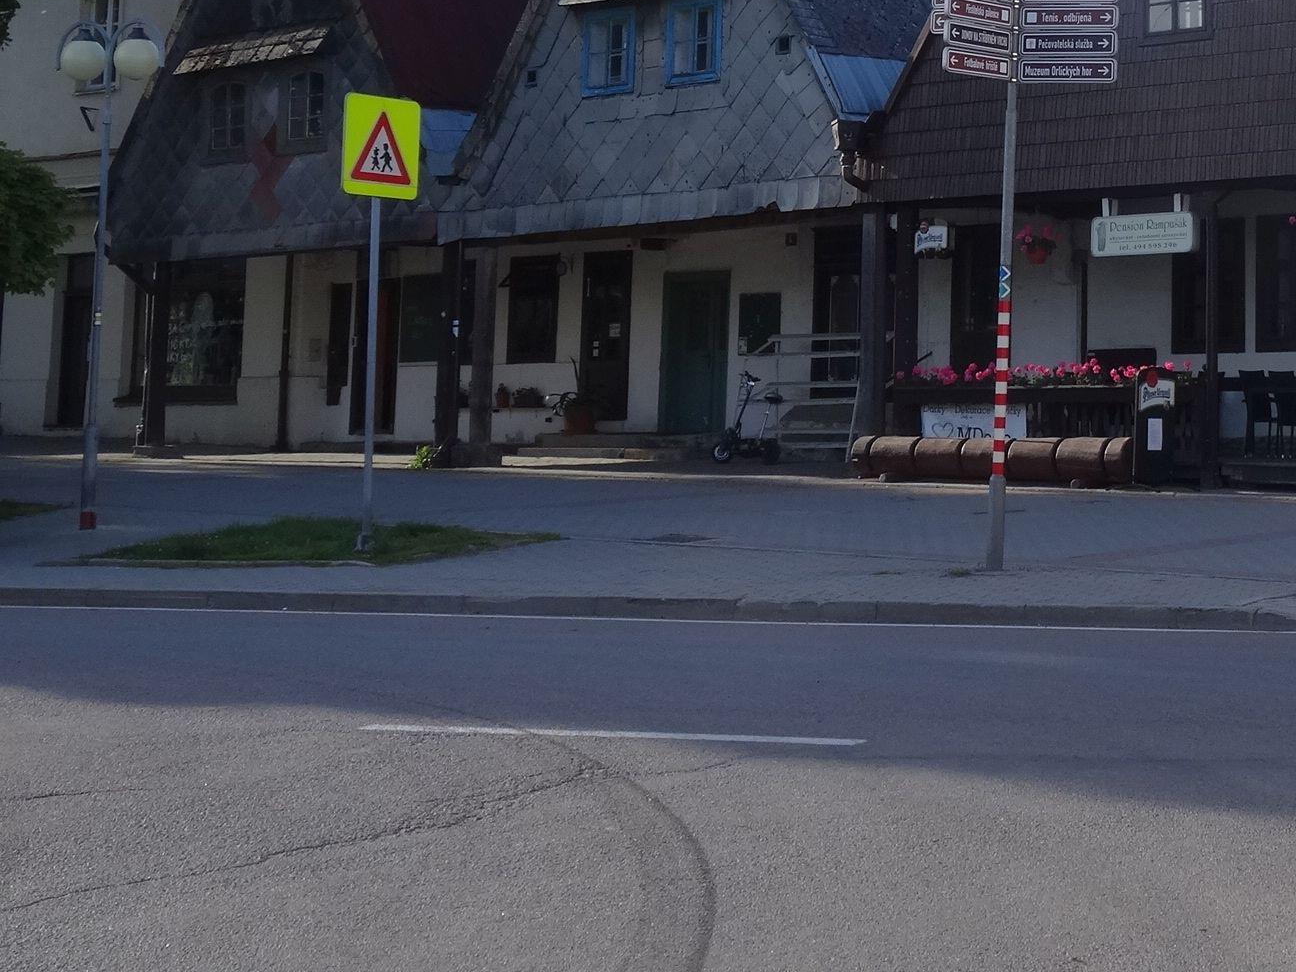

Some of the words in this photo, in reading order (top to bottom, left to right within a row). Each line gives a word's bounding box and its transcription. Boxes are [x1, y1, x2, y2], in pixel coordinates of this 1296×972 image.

[1038, 38, 1075, 49] Pečovatelská
[1075, 38, 1093, 49] služba
[1024, 65, 1050, 76] Muzeum
[1051, 65, 1081, 78] Orlických
[1081, 65, 1093, 76] hor
[1109, 220, 1144, 232] Pension
[1146, 218, 1188, 232] Rampušák
